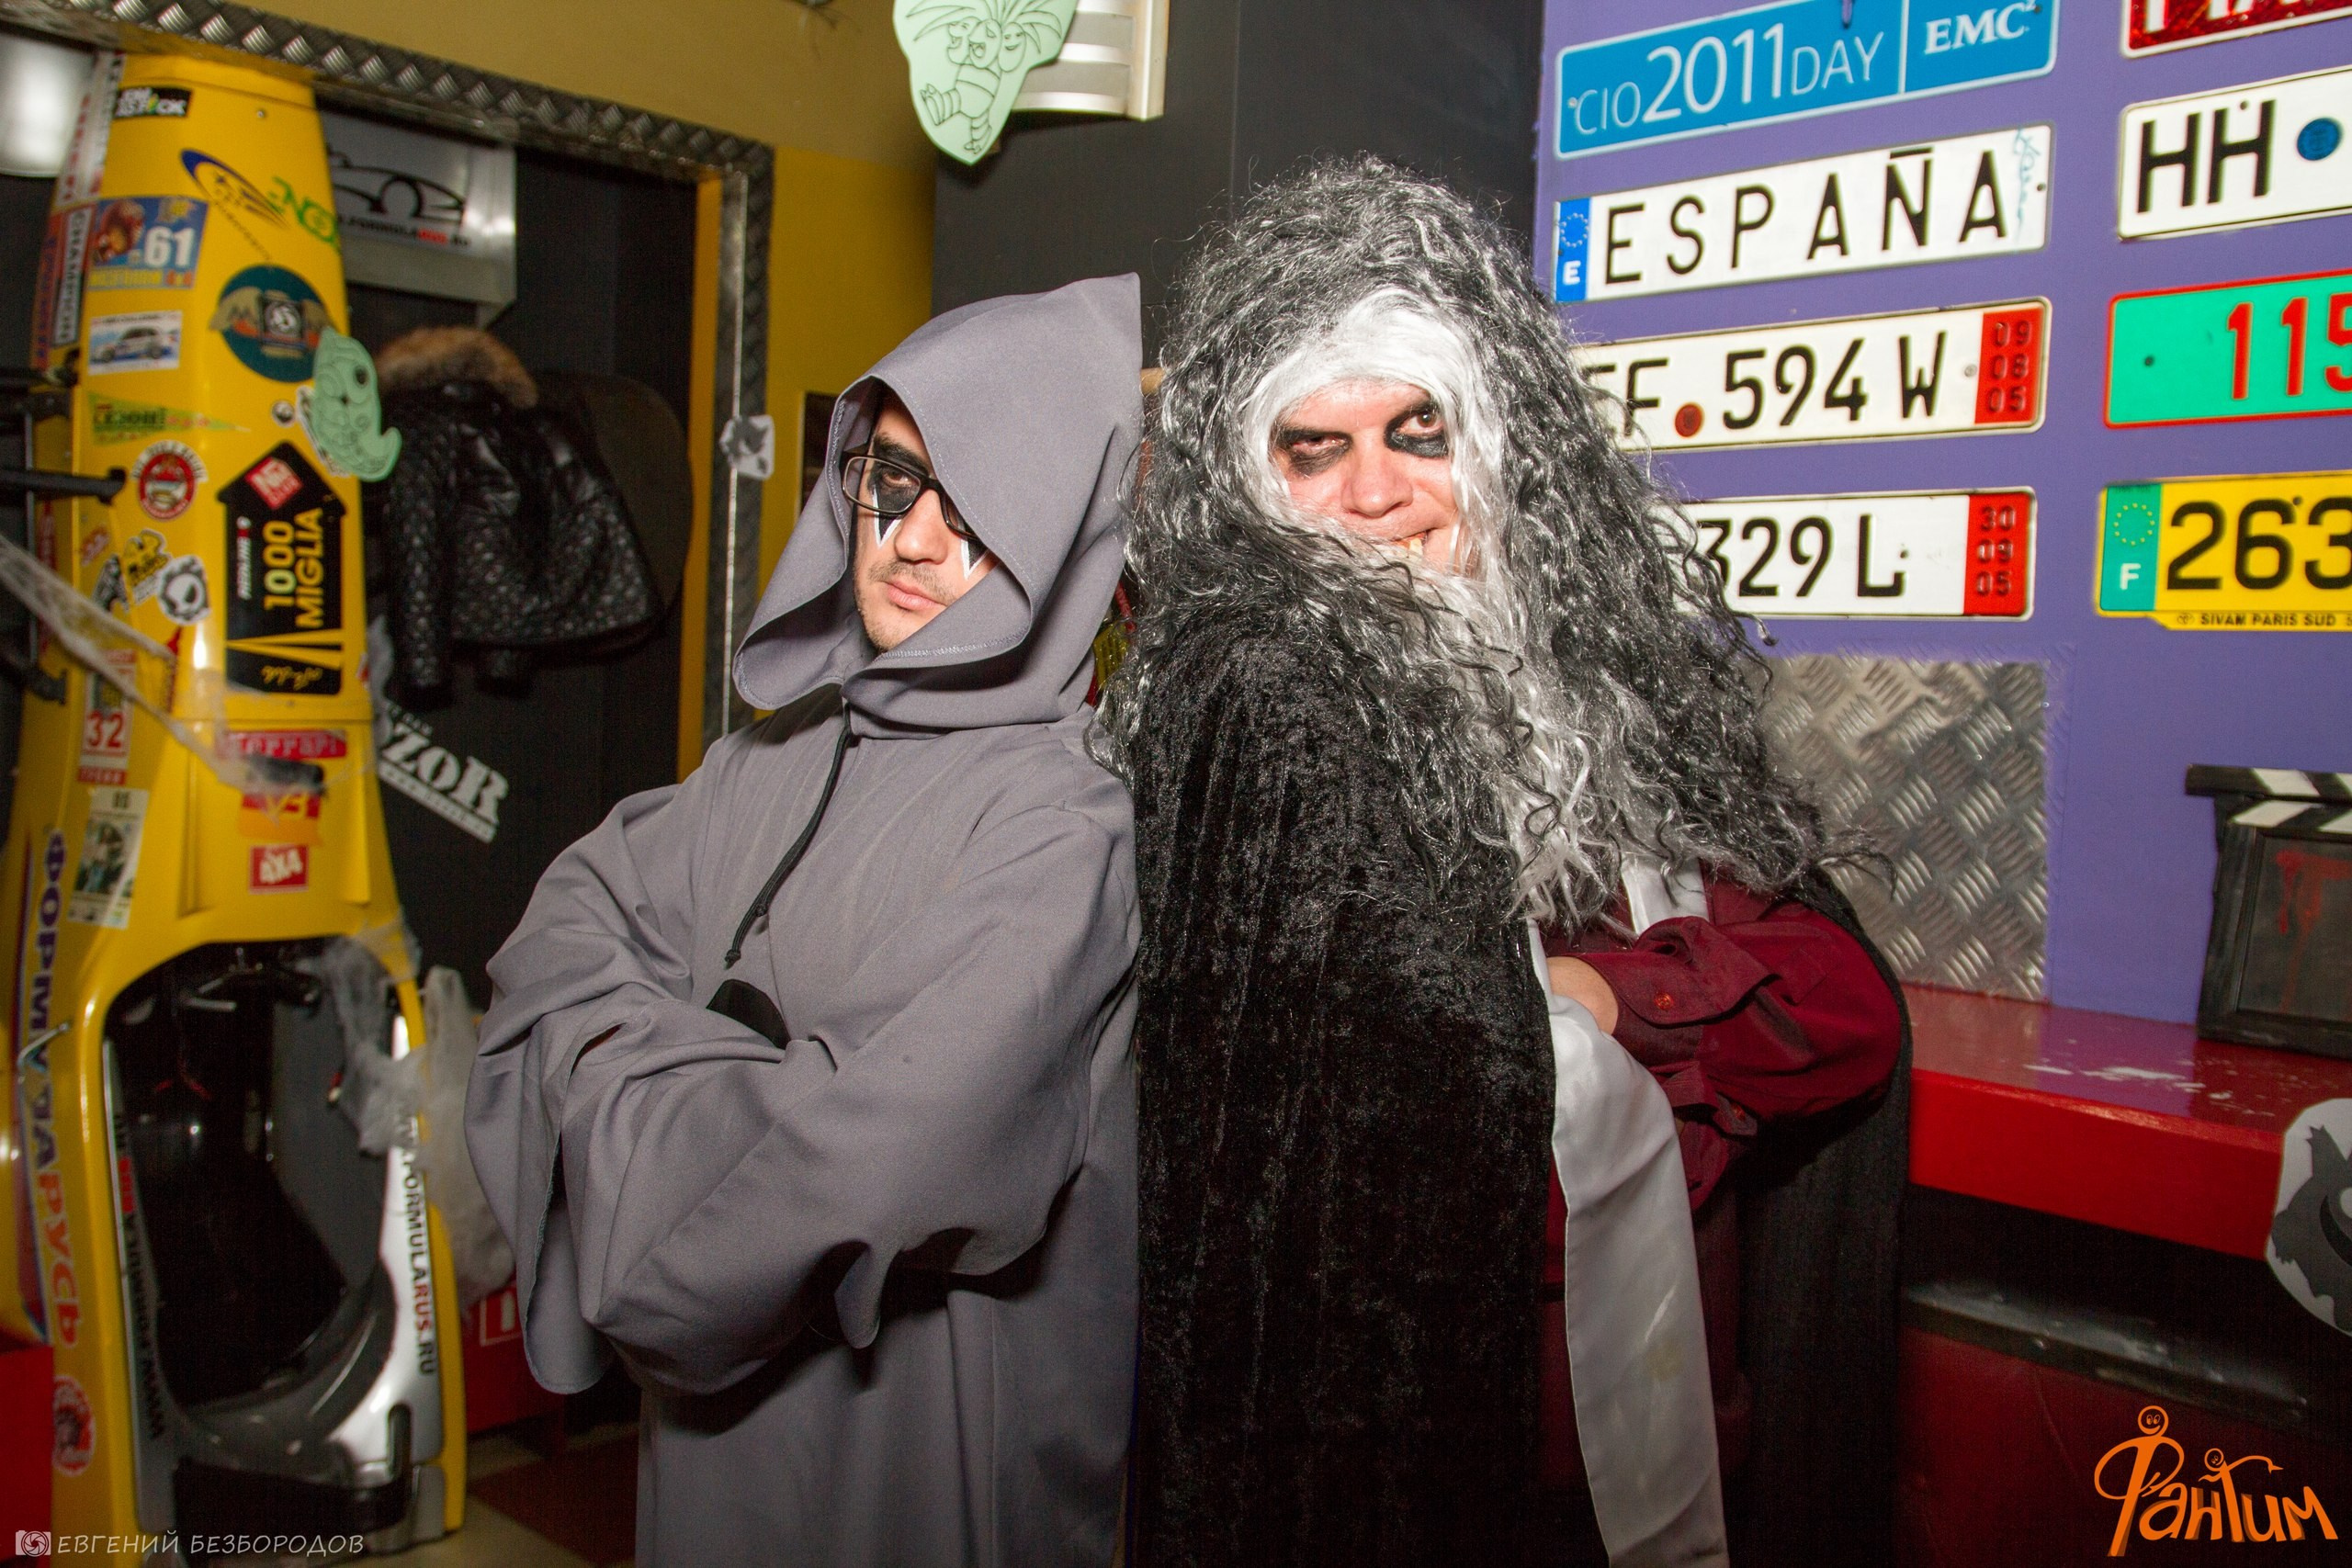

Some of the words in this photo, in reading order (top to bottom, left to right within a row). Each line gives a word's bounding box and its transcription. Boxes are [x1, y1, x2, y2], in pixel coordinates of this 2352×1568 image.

[2136, 98, 2277, 214] HH
[1604, 146, 2009, 286] ESPAÑA
[143, 225, 196, 267] 61
[1563, 260, 1582, 286] E
[1995, 320, 2032, 347] 09
[1721, 337, 1868, 431] 594
[1898, 330, 1948, 420] W
[1992, 354, 2029, 379] 08
[1988, 386, 2027, 412] 05
[1980, 505, 2016, 532] 30
[2165, 496, 2352, 592] 263
[262, 520, 297, 611] 1000
[294, 507, 324, 628] MIGLIA
[2120, 562, 2142, 591] F
[1976, 570, 2011, 597] 05
[2200, 613, 2247, 626] SIVAM
[2253, 613, 2298, 626] PARIS
[2303, 613, 2337, 626] SUD
[87, 710, 125, 748] 32
